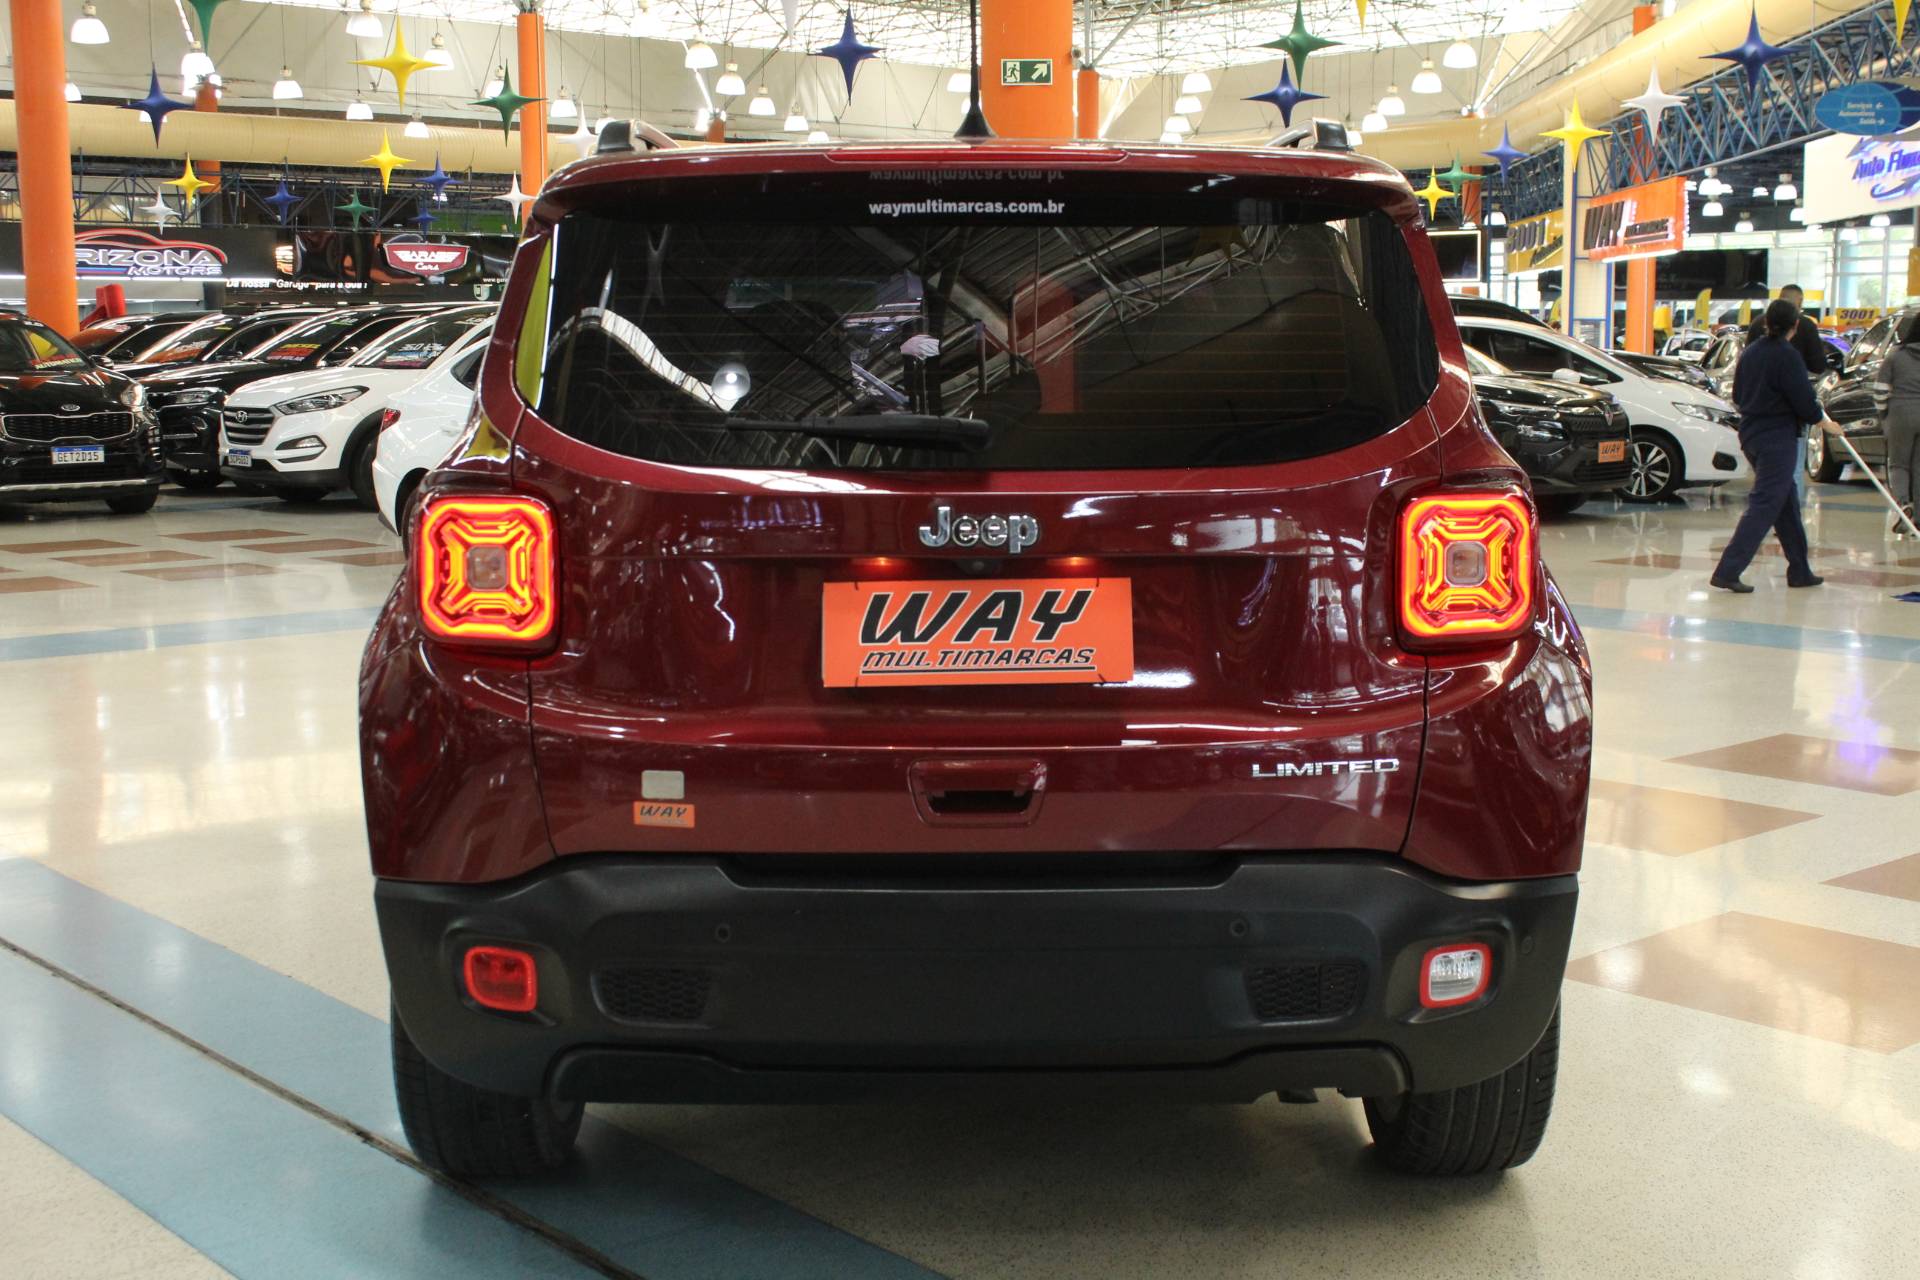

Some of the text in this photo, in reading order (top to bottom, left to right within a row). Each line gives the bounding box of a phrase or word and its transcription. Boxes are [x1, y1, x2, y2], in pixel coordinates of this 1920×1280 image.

[869, 199, 1065, 217] waymultimarcas.com.br
[76, 248, 224, 267] RIZONA
[1839, 309, 1875, 320] 3001
[918, 506, 1039, 554] Jeep
[859, 587, 1096, 646] WAY
[861, 647, 1097, 669] MULTIMARCAS
[1252, 758, 1400, 777] LIMITED
[639, 805, 688, 818] WAY
